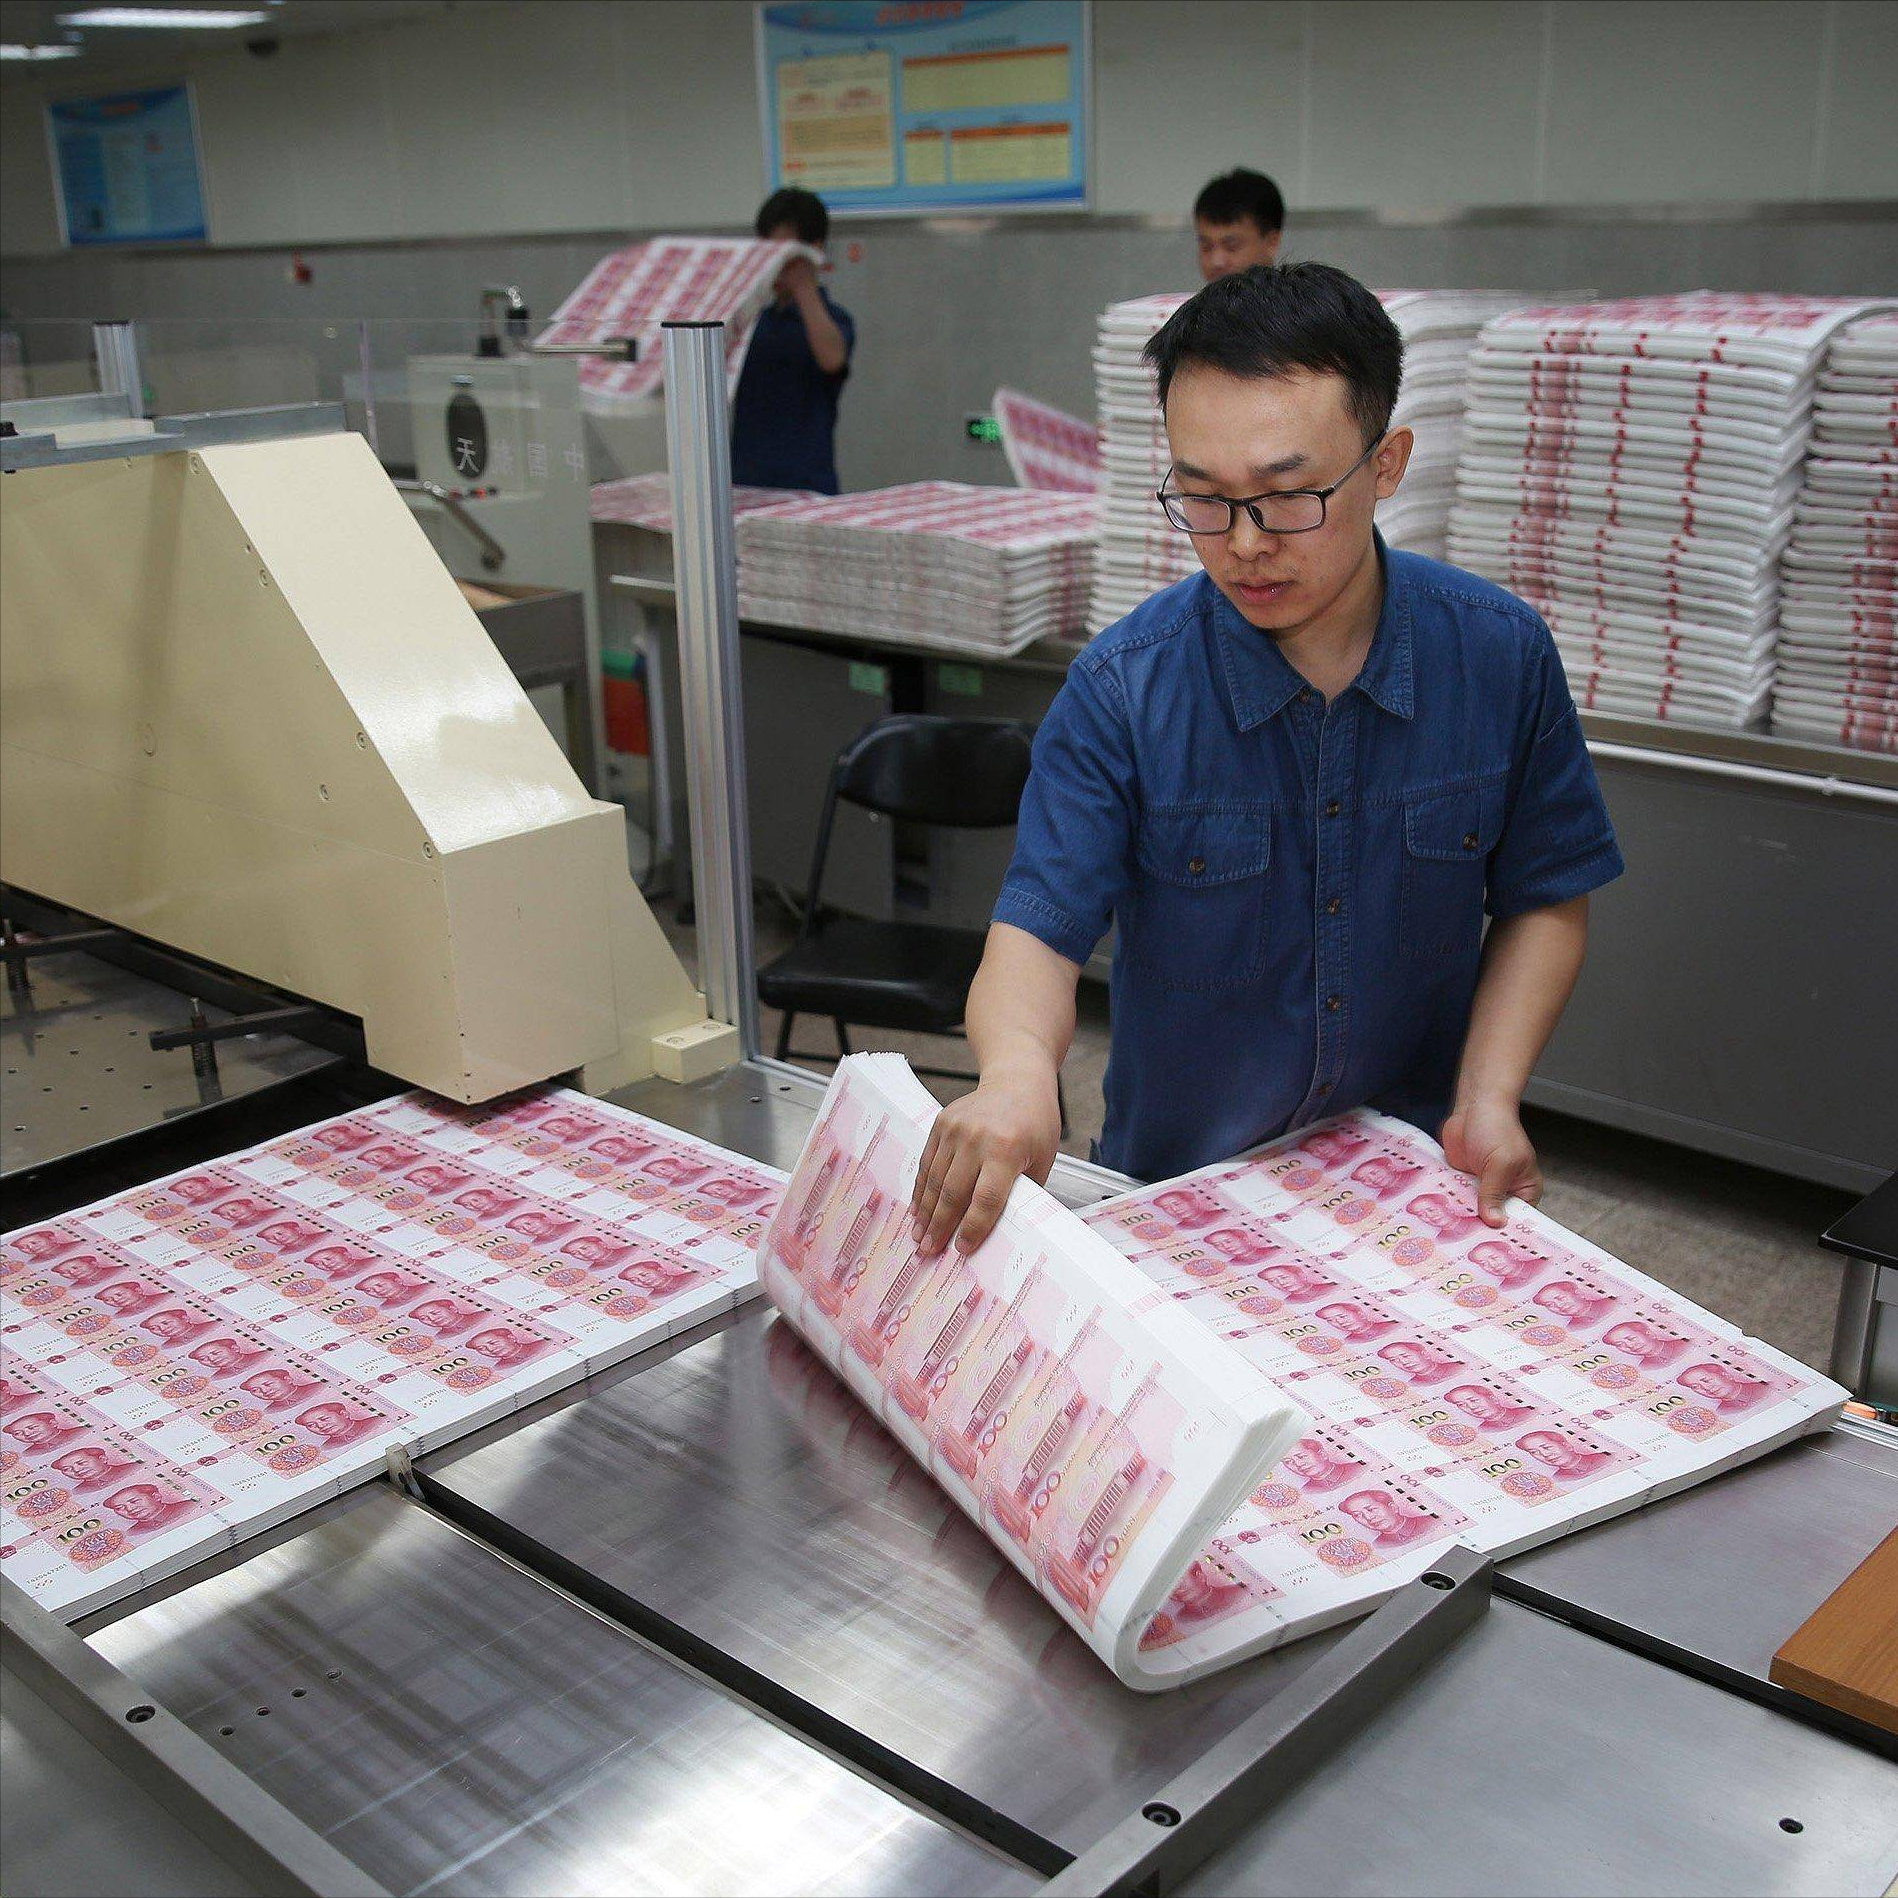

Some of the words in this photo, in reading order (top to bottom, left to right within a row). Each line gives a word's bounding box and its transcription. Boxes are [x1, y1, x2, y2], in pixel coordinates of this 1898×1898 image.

[511, 1135, 541, 1149] 100
[282, 1145, 313, 1158] 100
[328, 1165, 359, 1180] 100
[563, 1156, 593, 1171] 100
[1269, 1159, 1301, 1176] 100
[375, 1186, 406, 1202] 100
[615, 1178, 646, 1193] 100
[135, 1197, 167, 1211] 100
[671, 1199, 703, 1214] 100
[1320, 1190, 1353, 1210] 100
[424, 1210, 456, 1225] 100
[1121, 1212, 1154, 1227] 100
[178, 1220, 210, 1235] 100
[730, 1222, 762, 1240] 100
[476, 1235, 508, 1251] 100
[1376, 1225, 1411, 1250] 100
[224, 1244, 257, 1260] 100
[1171, 1249, 1205, 1263] 100
[531, 1260, 564, 1278] 100
[271, 1270, 305, 1287] 100
[1438, 1273, 1474, 1295] 100
[14, 1280, 49, 1296] 100
[589, 1287, 623, 1306] 100
[1224, 1285, 1259, 1301] 100
[56, 1307, 92, 1324] 100
[322, 1298, 356, 1315] 100
[883, 1304, 911, 1346] 100
[1504, 1314, 1541, 1331] 100
[375, 1326, 411, 1345] 100
[1281, 1324, 1318, 1340] 100
[102, 1336, 138, 1354] 100
[431, 1356, 469, 1377] 100
[1572, 1354, 1611, 1373] 100
[150, 1368, 187, 1387] 100
[929, 1356, 959, 1404] 100
[1342, 1365, 1380, 1382] 100
[201, 1400, 240, 1419] 100
[1647, 1395, 1688, 1418] 100
[1408, 1410, 1450, 1429] 100
[978, 1411, 1008, 1460] 100
[255, 1435, 295, 1456] 100
[1479, 1457, 1521, 1478] 100
[4, 1479, 49, 1503] 100
[1031, 1471, 1061, 1520] 100
[57, 1519, 102, 1545] 100
[1300, 1521, 1344, 1544] 100
[1090, 1535, 1120, 1588] 100
